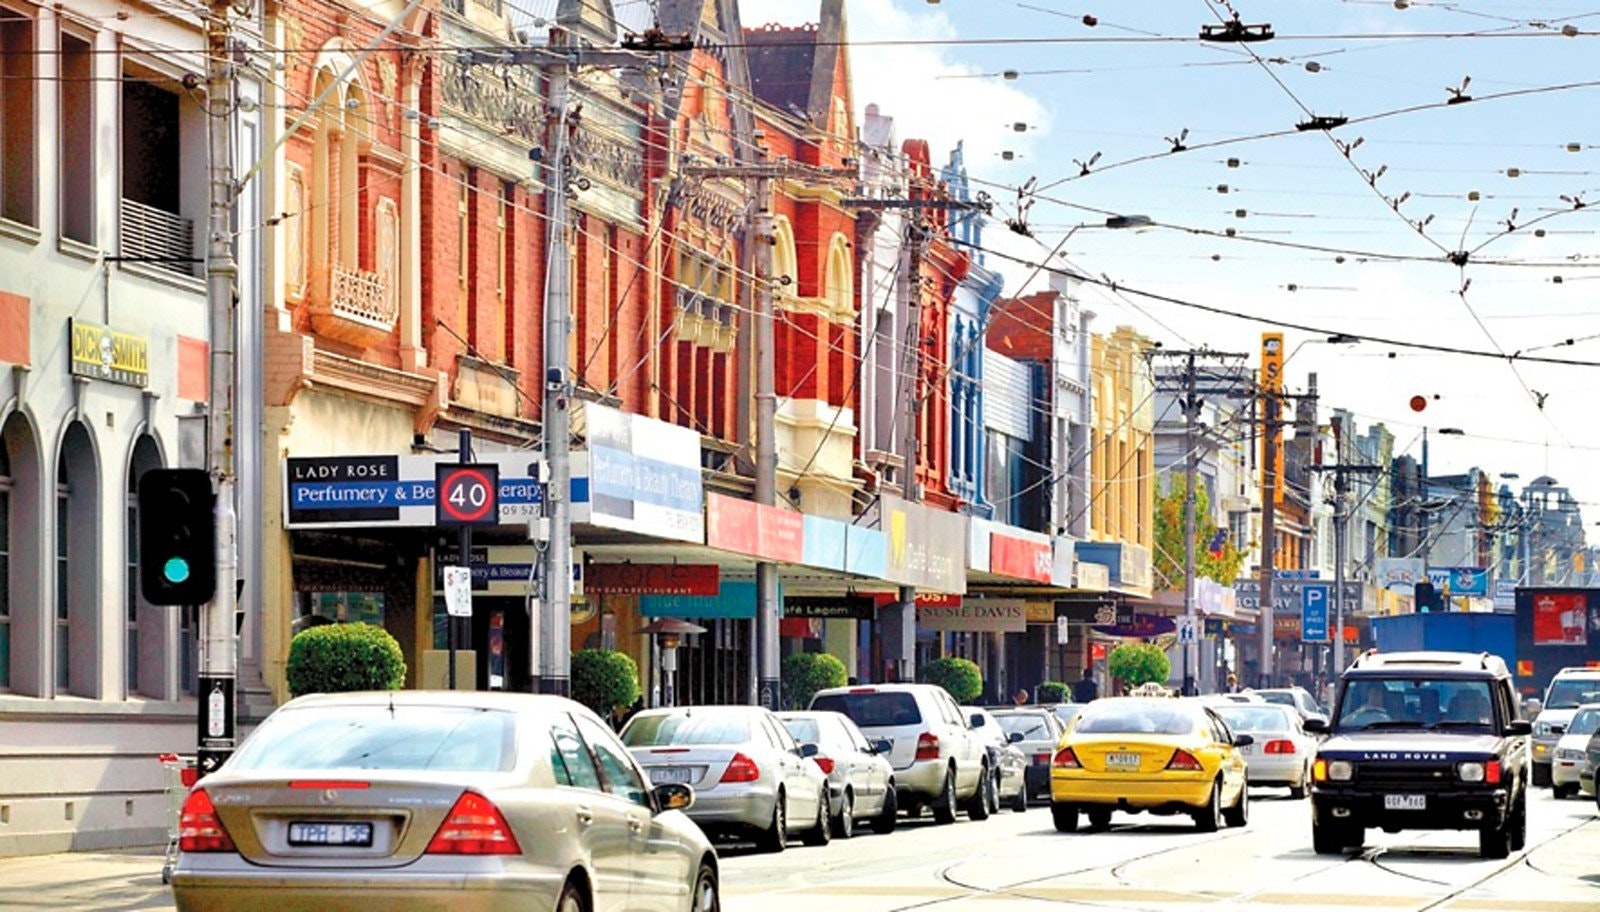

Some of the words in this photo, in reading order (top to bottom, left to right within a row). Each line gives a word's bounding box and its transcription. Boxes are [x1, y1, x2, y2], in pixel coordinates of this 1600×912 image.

[112, 335, 147, 370] SMITH
[295, 465, 339, 478] LADY
[347, 463, 388, 477] ROSE
[297, 485, 389, 503] Perfumery
[394, 486, 407, 500] &
[449, 483, 487, 507] 40
[437, 554, 460, 563] LADY
[1307, 589, 1323, 607] P
[923, 606, 968, 618] SUSIE
[974, 606, 1021, 618] DAVIS
